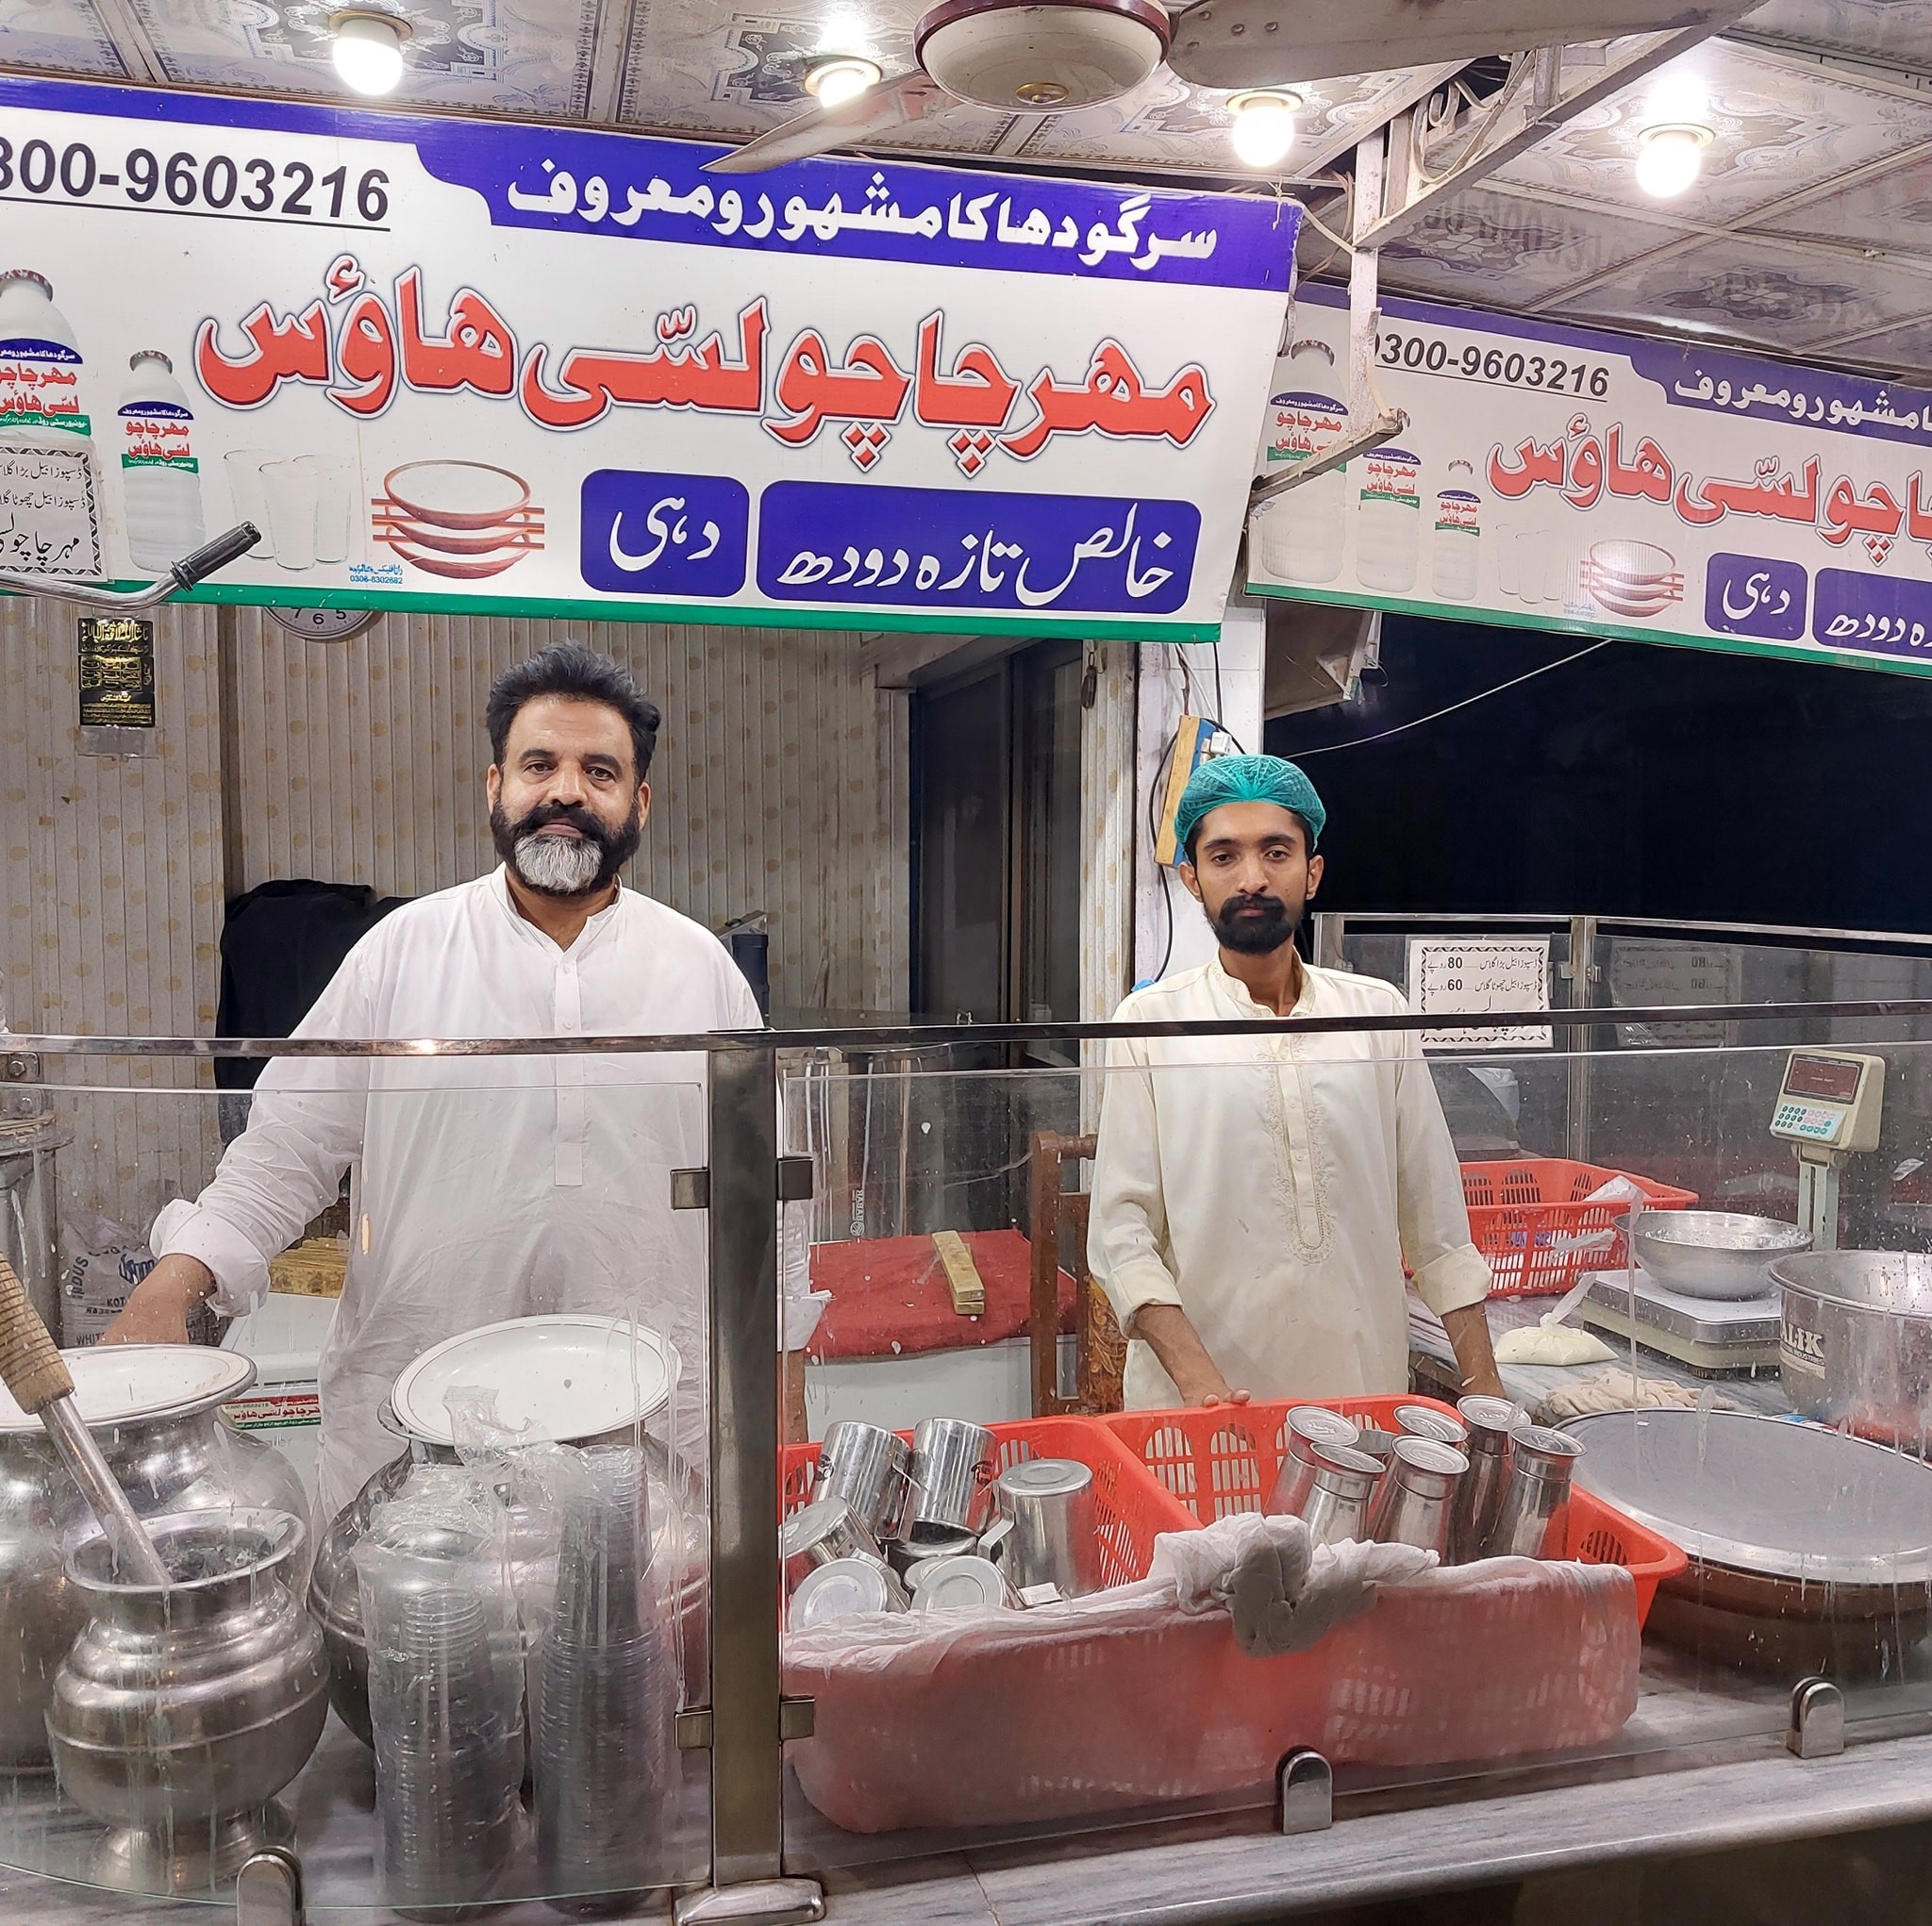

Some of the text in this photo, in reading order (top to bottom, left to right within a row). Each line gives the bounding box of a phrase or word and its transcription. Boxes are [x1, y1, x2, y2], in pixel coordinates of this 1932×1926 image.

[1015, 502, 1174, 606] خالص
[776, 545, 910, 588] دودھ
[312, 613, 325, 624] 6
[335, 609, 346, 620] 5
[1447, 956, 1463, 969] 80
[1447, 979, 1463, 991] 60
